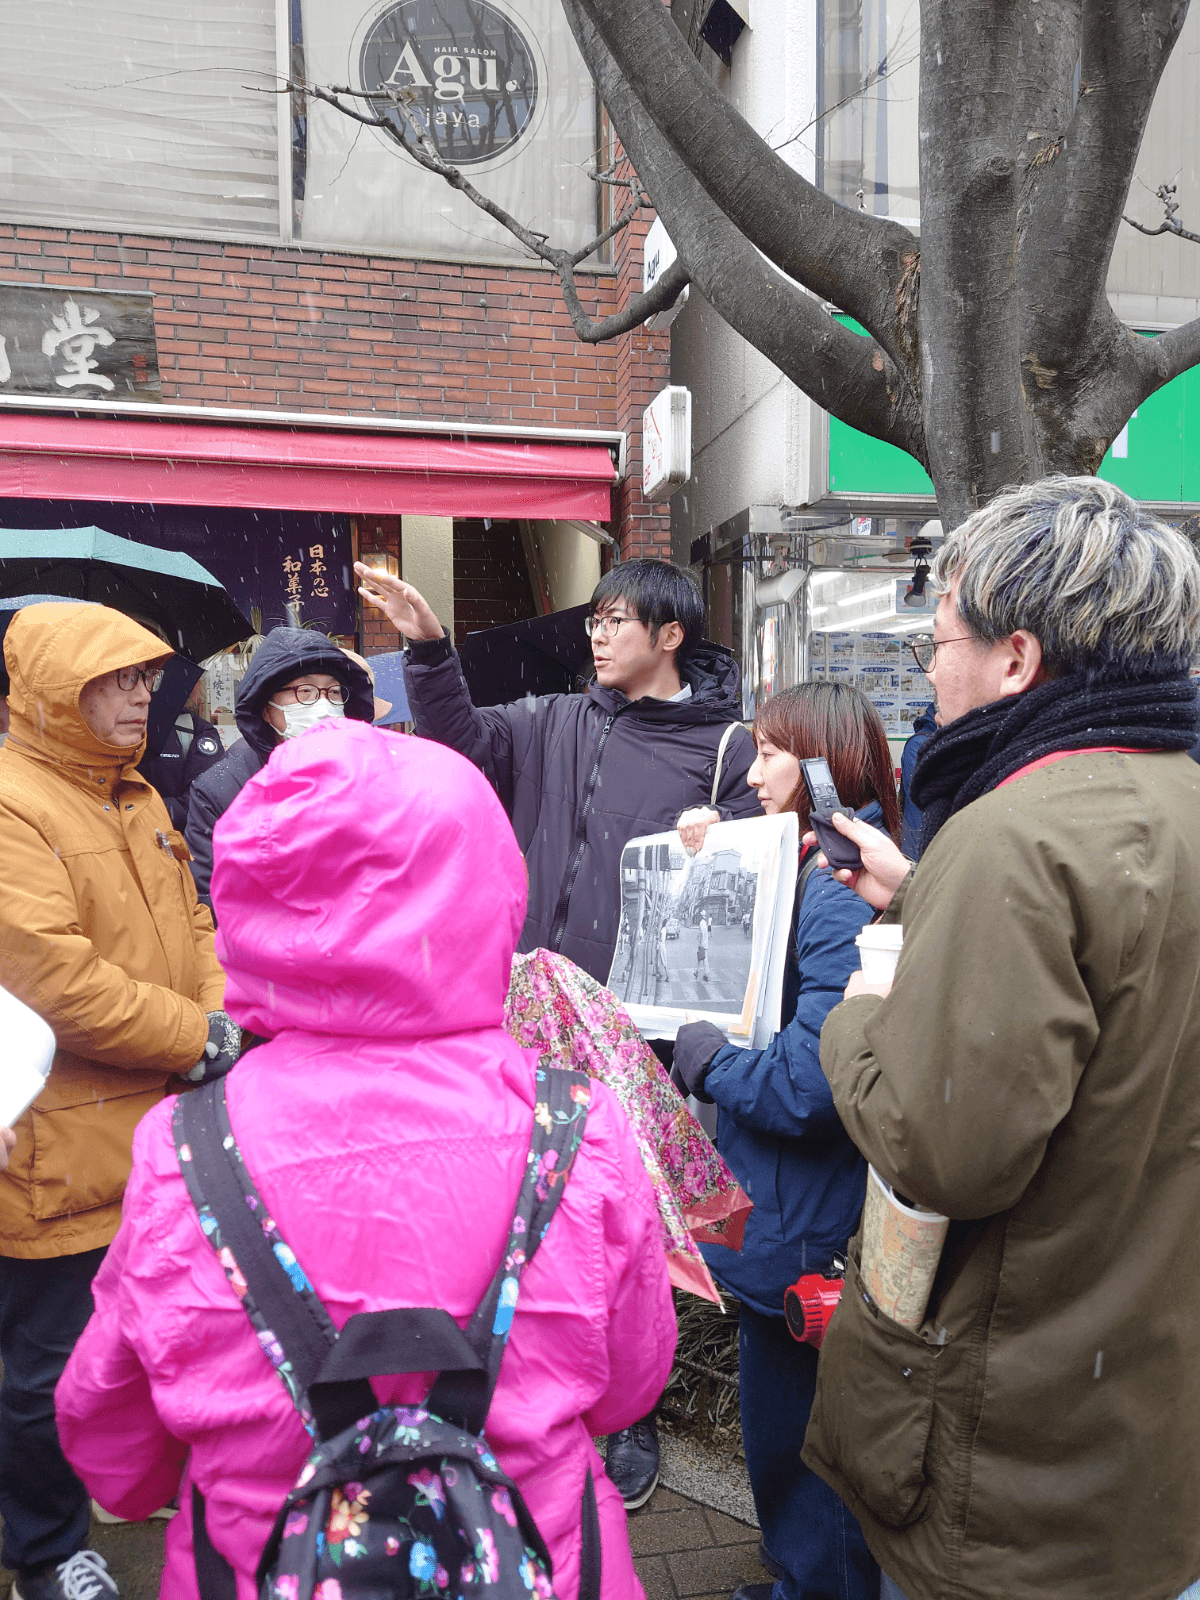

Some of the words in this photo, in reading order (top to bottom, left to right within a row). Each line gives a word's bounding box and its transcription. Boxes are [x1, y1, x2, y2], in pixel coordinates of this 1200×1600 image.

[434, 46, 459, 54] HAIR
[463, 47, 497, 56] SALON
[425, 107, 481, 128] jaya
[0, 299, 117, 392] 堂
[281, 554, 305, 613] 和菓子
[308, 543, 330, 598] 日本の心
